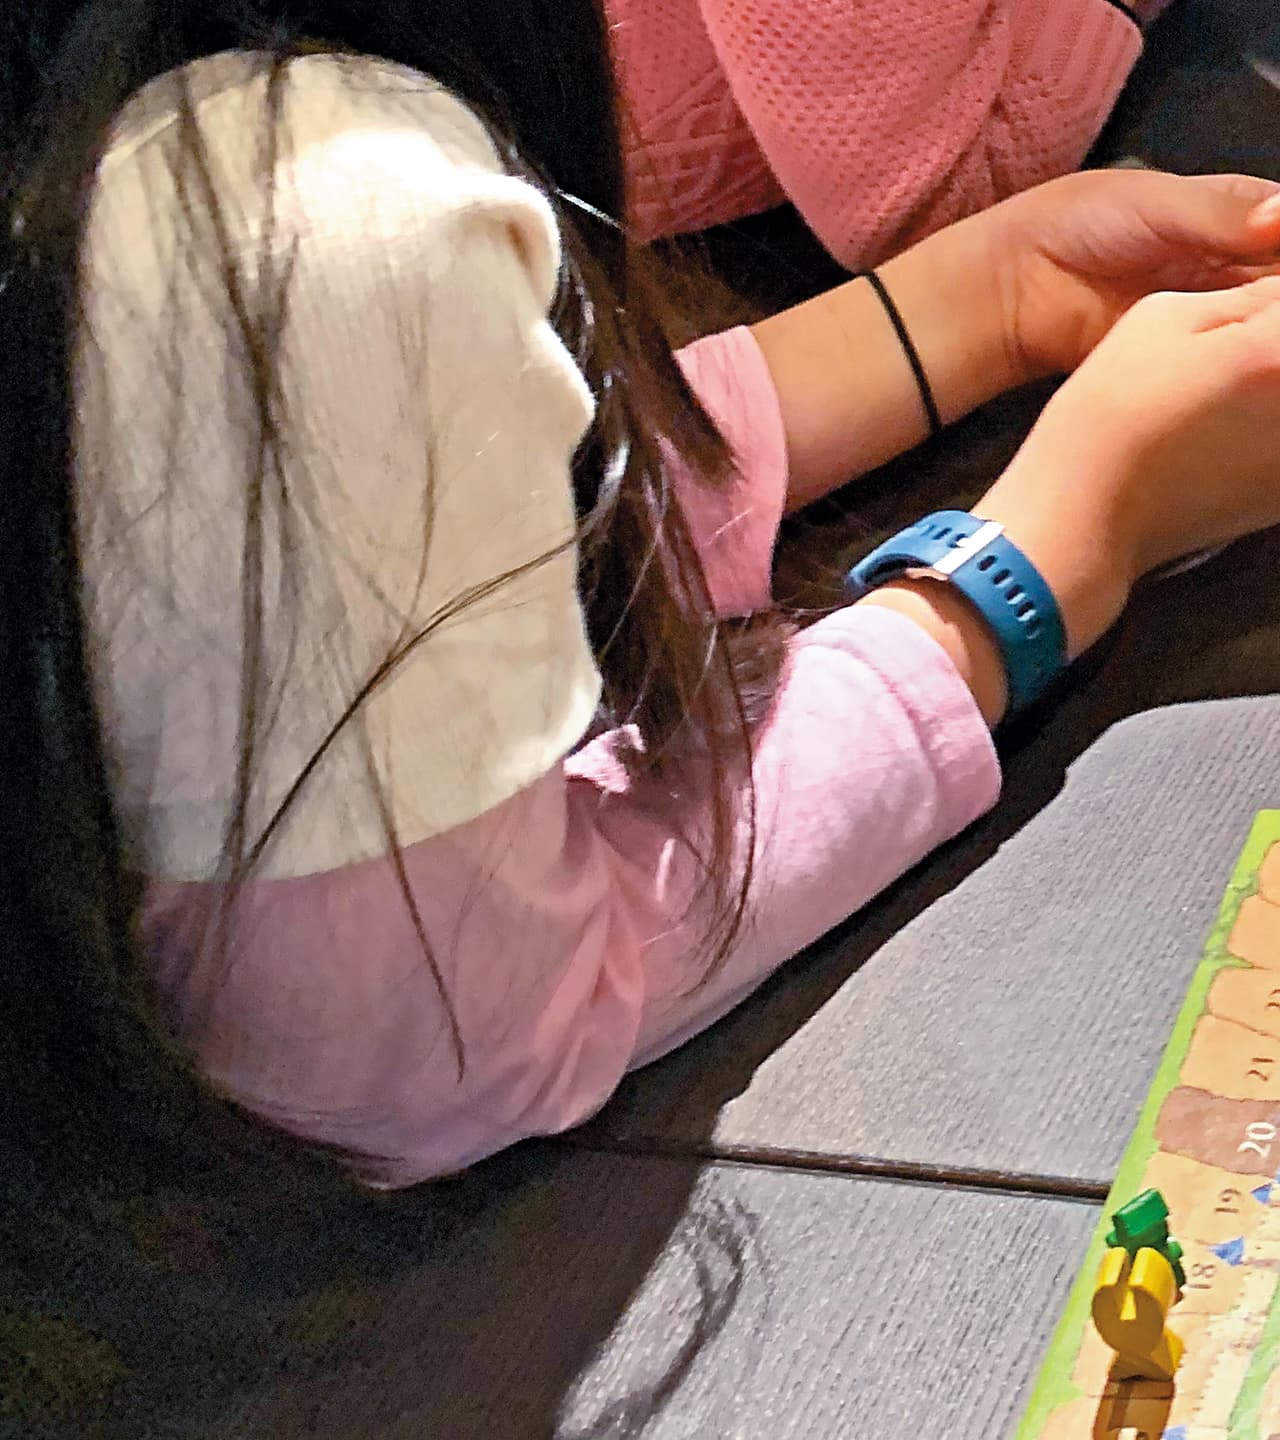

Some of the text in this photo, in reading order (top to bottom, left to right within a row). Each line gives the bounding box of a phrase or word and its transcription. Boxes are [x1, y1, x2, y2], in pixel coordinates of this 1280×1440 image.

[1245, 1056, 1275, 1082] 21
[1237, 1121, 1277, 1158] 20
[1214, 1187, 1242, 1214] 19
[1187, 1262, 1217, 1290] 18
